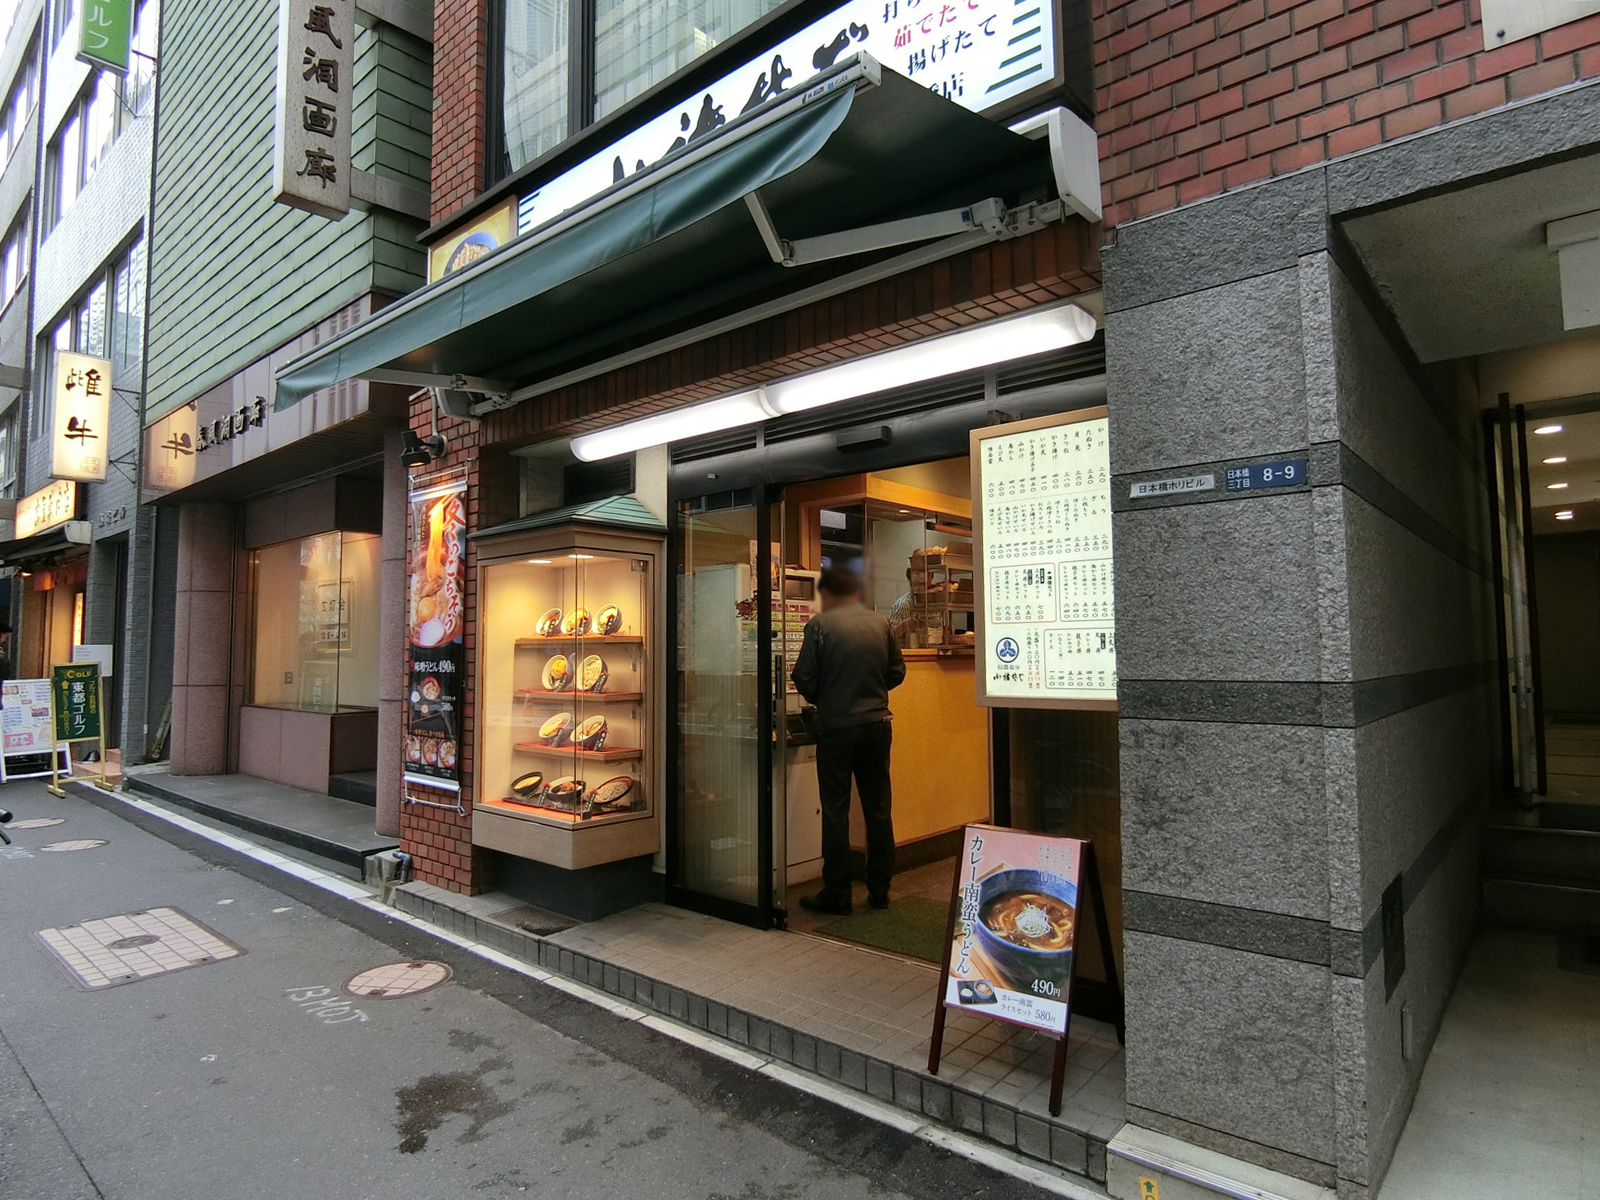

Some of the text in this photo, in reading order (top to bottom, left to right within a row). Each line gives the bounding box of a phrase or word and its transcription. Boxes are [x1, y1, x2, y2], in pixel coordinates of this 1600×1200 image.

[86, 0, 113, 49] ルフ
[907, 14, 997, 76] 揚げたて
[297, 0, 343, 189] 風洞画廊
[64, 368, 103, 447] 雌牛
[1098, 428, 1104, 446] かけ
[1227, 465, 1295, 482] 日本橋 8-9
[1138, 478, 1206, 494] 日本橋ホリビル
[1228, 478, 1250, 490] 三丁目
[1100, 494, 1106, 514] もり
[72, 681, 86, 736] 東都ゴルフ
[956, 835, 983, 974] カレー南蛮うどん
[1031, 978, 1061, 998] 490円
[1001, 994, 1034, 1008] カレー南蛮
[1001, 1003, 1032, 1017] ライスセット
[1035, 1008, 1056, 1023] 580円
